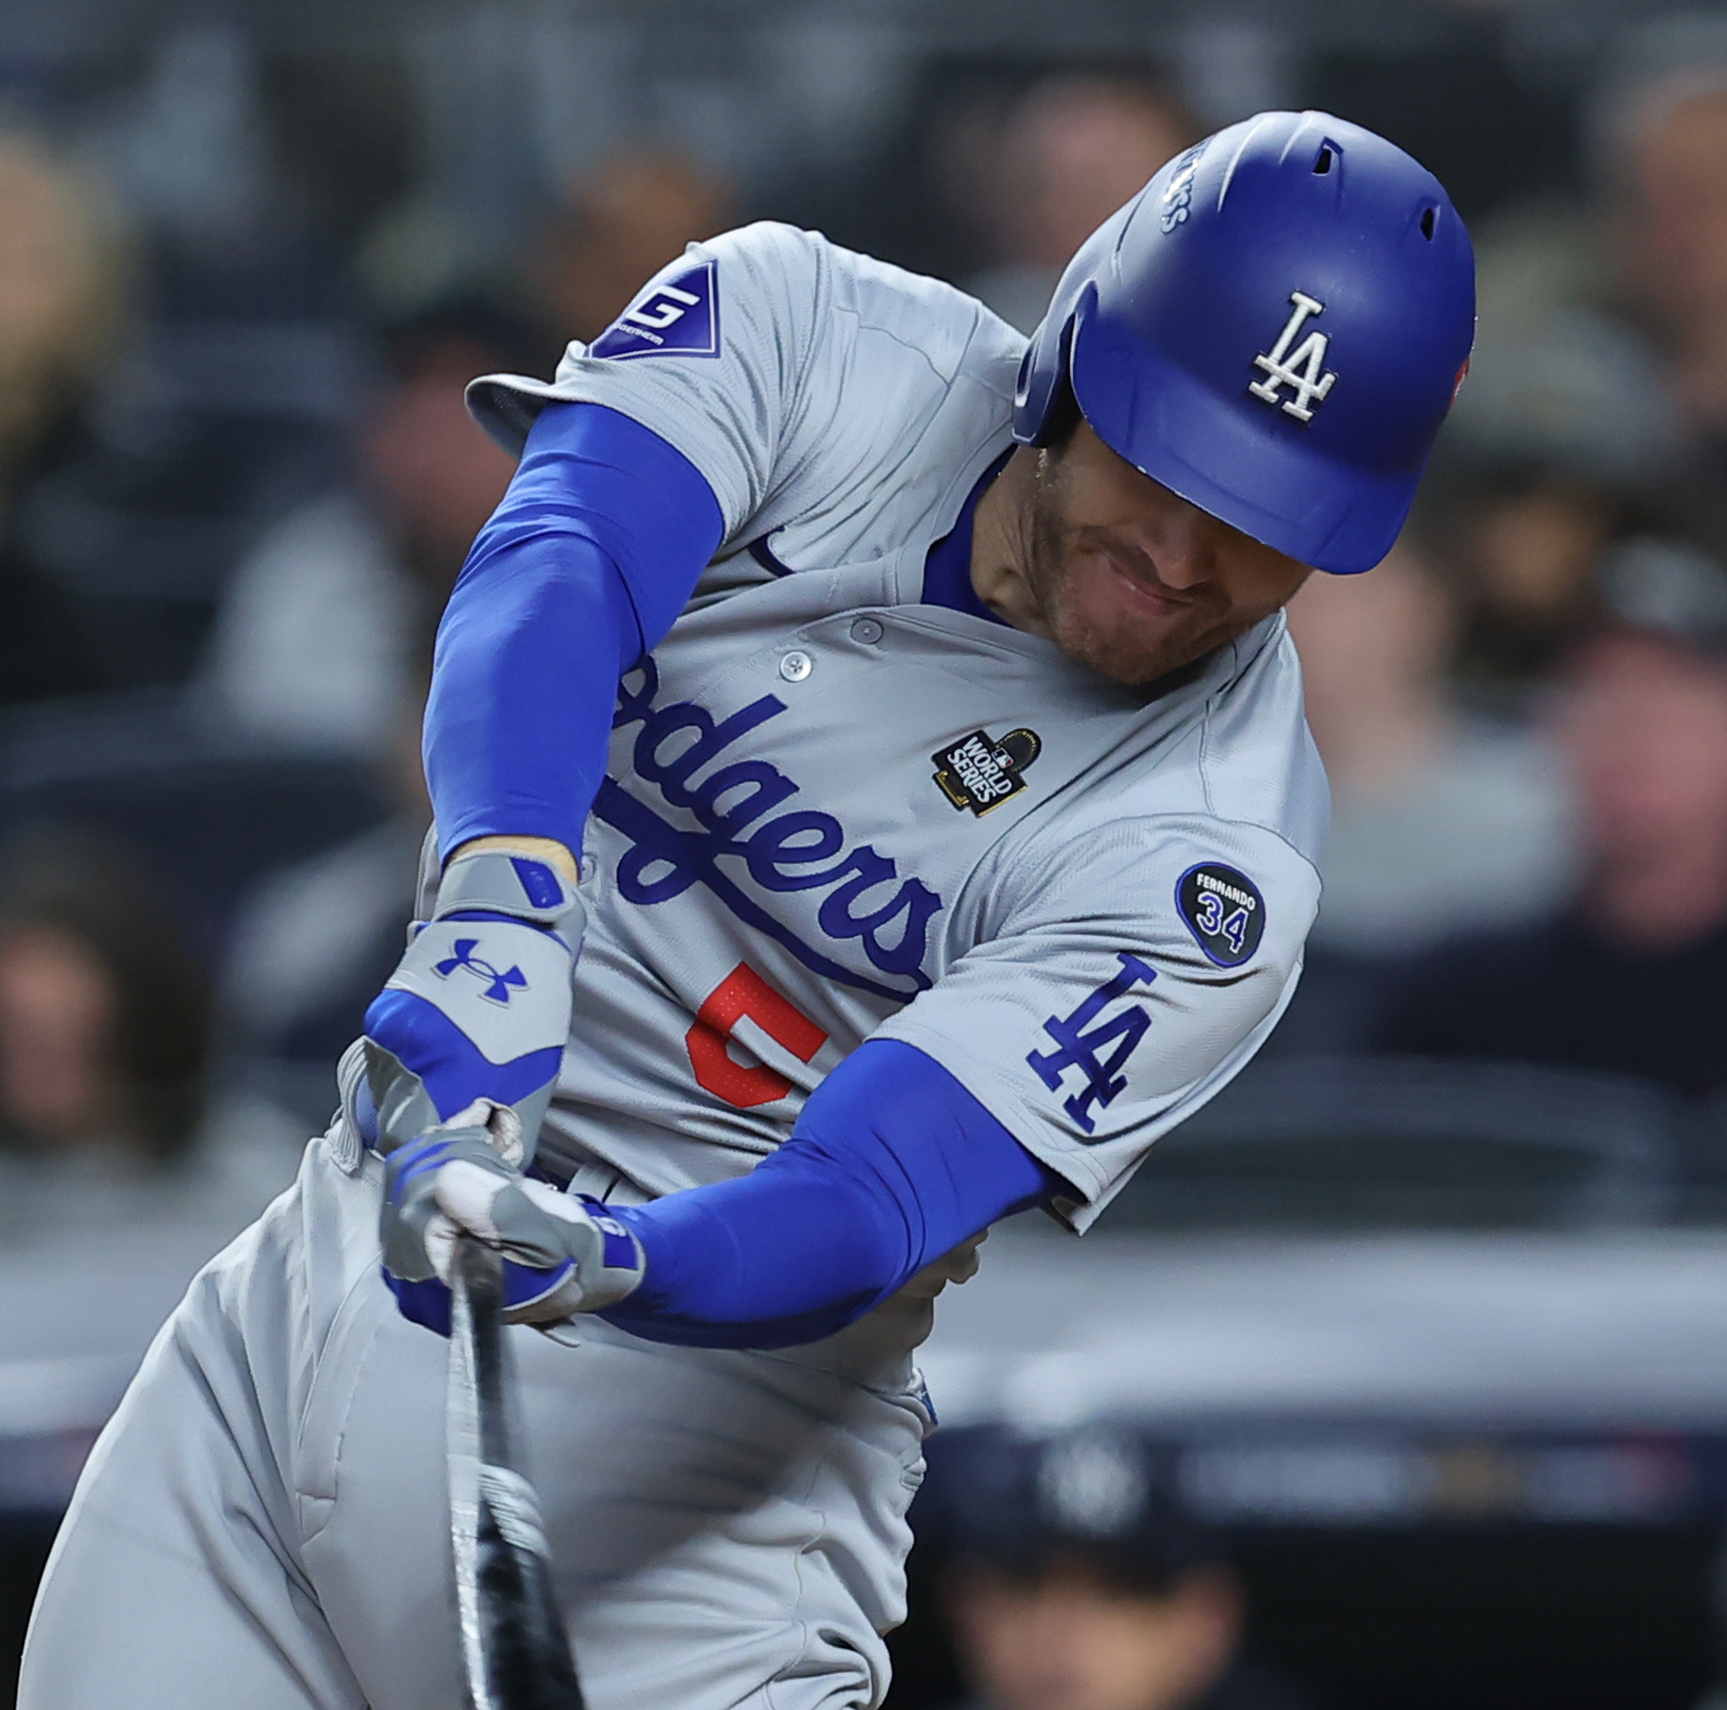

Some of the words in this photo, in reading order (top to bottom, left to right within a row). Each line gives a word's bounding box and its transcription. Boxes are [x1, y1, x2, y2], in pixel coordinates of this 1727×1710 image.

[1248, 289, 1338, 423] LA
[946, 748, 997, 804] SERIES
[962, 735, 1013, 795] WORLD
[591, 653, 945, 1004] odgers
[1196, 873, 1256, 912] FERNANDO
[1196, 891, 1249, 954] 34
[1025, 952, 1158, 1135] LA
